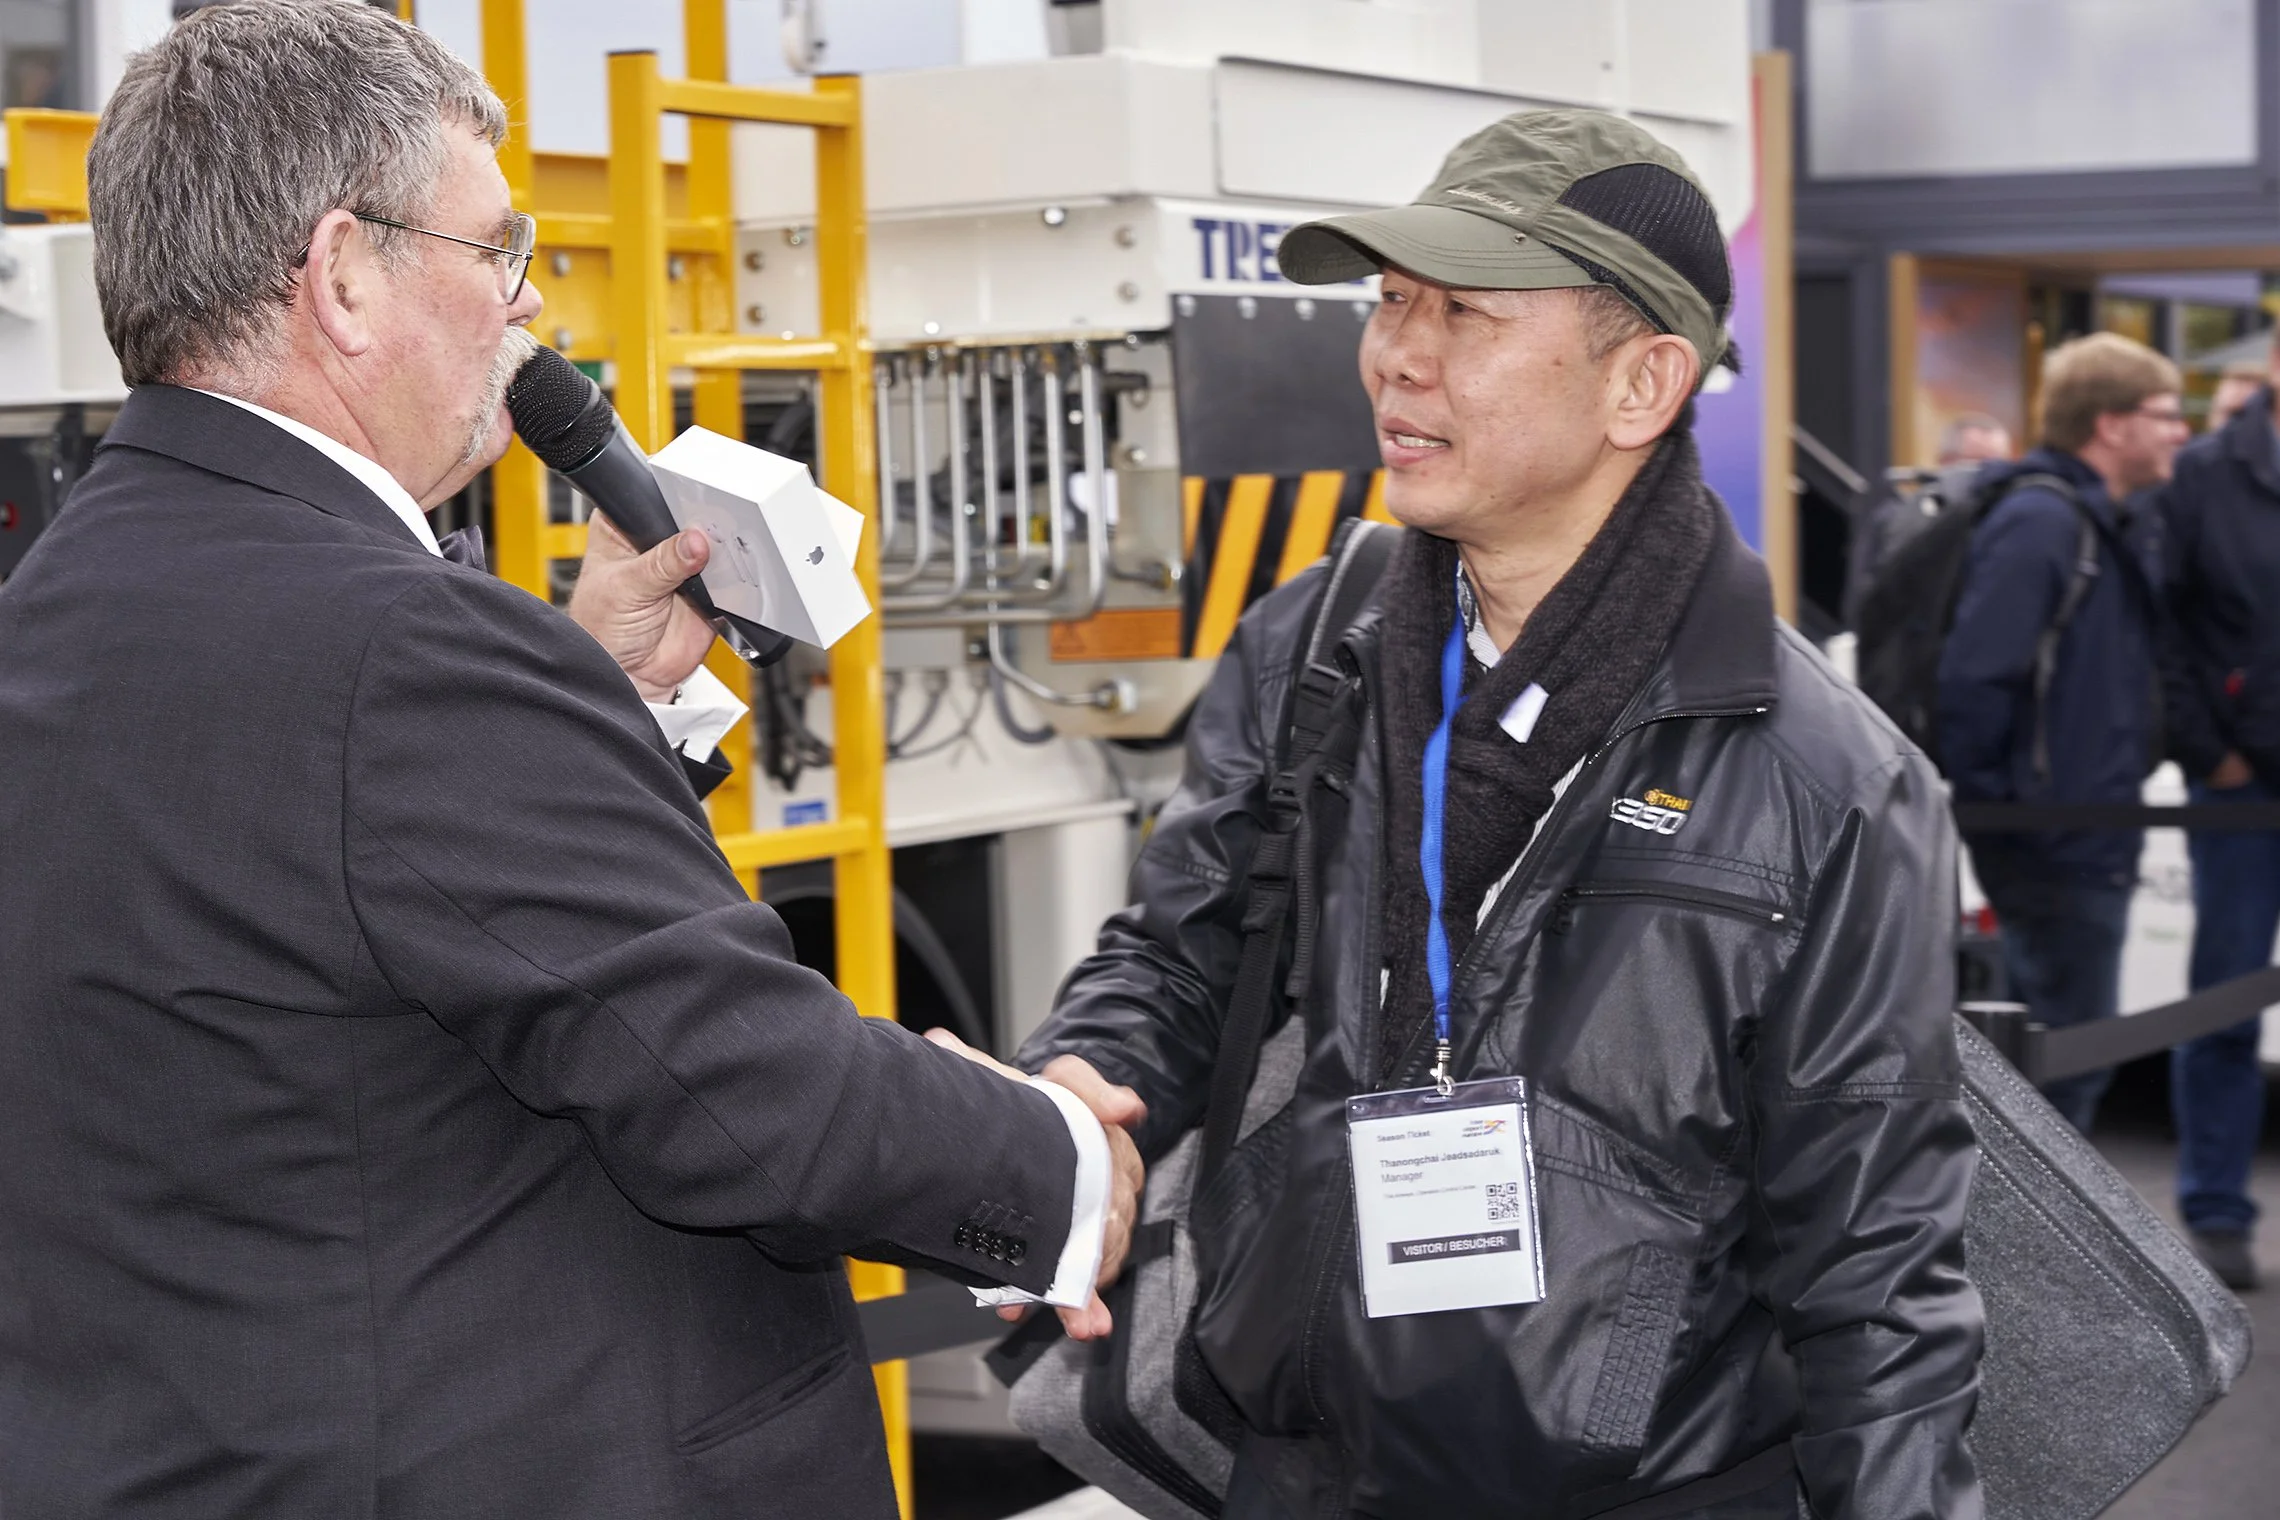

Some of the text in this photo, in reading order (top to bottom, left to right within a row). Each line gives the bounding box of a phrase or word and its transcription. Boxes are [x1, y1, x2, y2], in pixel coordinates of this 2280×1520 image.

[1407, 1129, 1431, 1139] Ticket
[1381, 1171, 1423, 1183] Manager
[1402, 1242, 1442, 1257] VISITOR
[1449, 1236, 1507, 1252] BESUCHER
